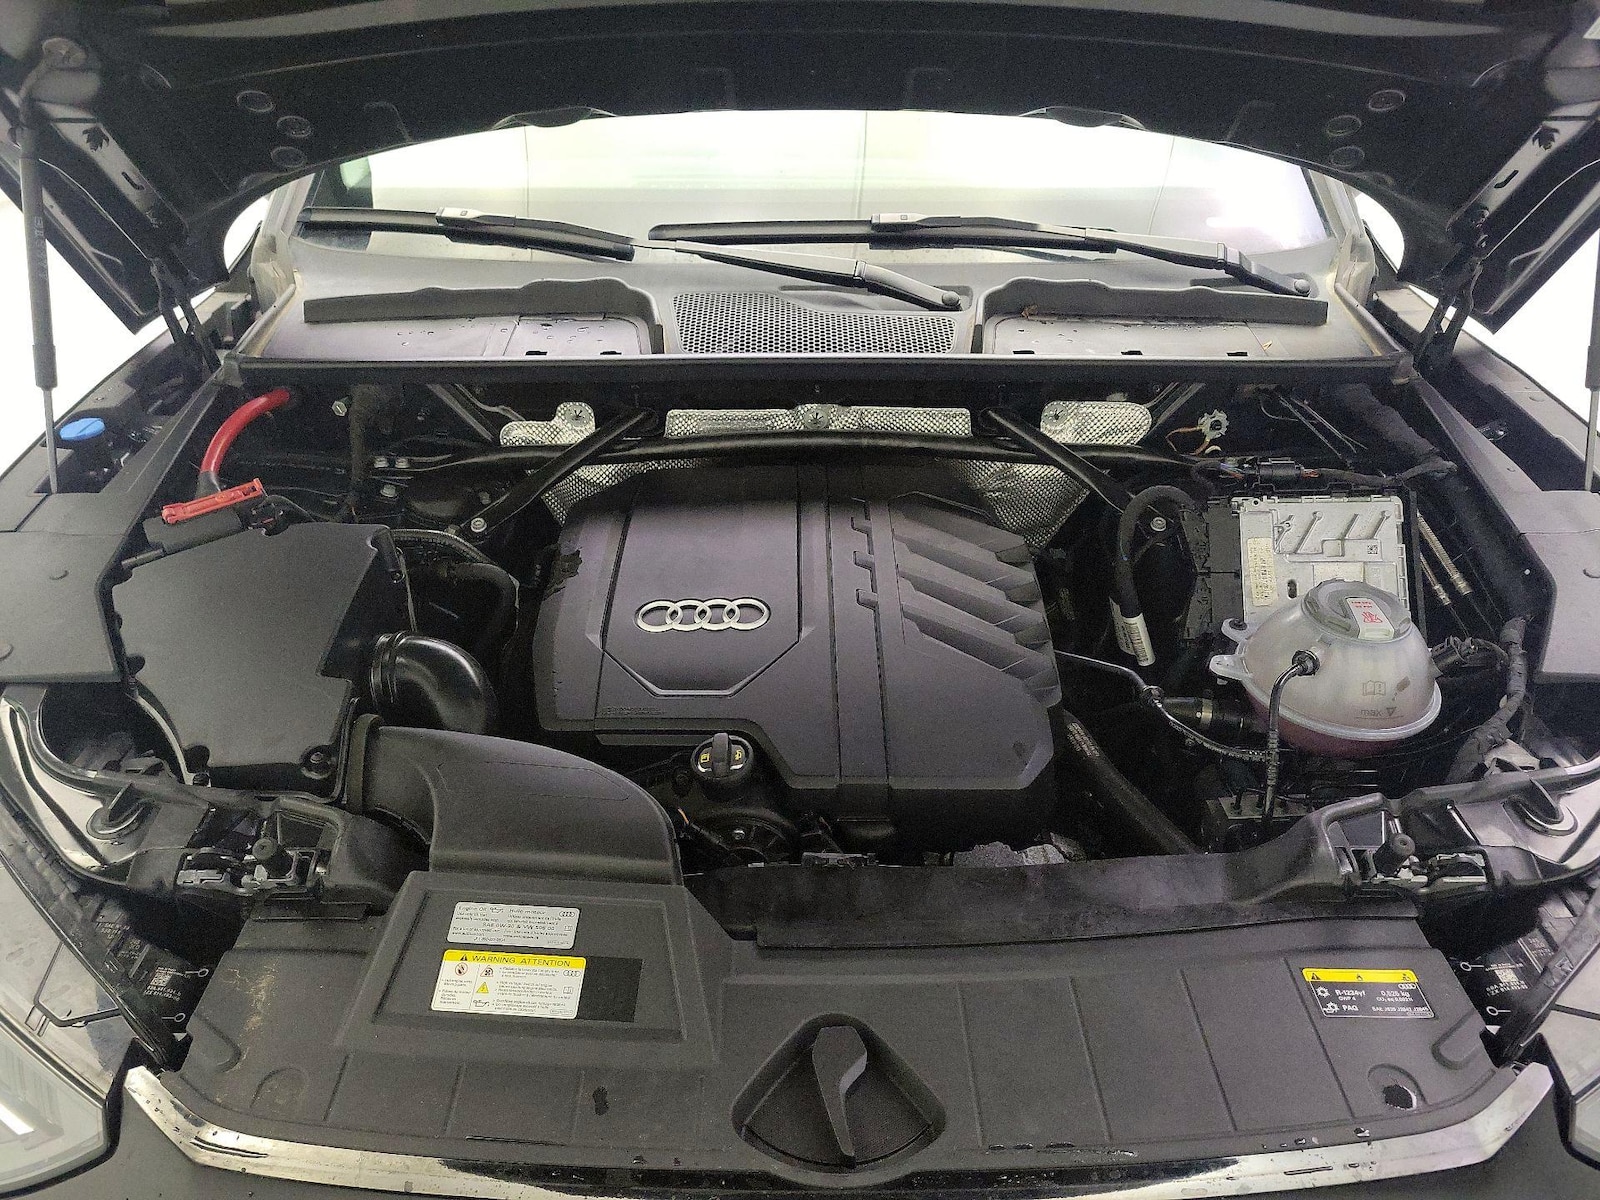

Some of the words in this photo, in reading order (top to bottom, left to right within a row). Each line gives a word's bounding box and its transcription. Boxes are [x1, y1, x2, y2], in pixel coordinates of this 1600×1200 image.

[1360, 709, 1382, 717] max
[472, 955, 516, 964] WARNING
[520, 958, 571, 967] ATTENTION
